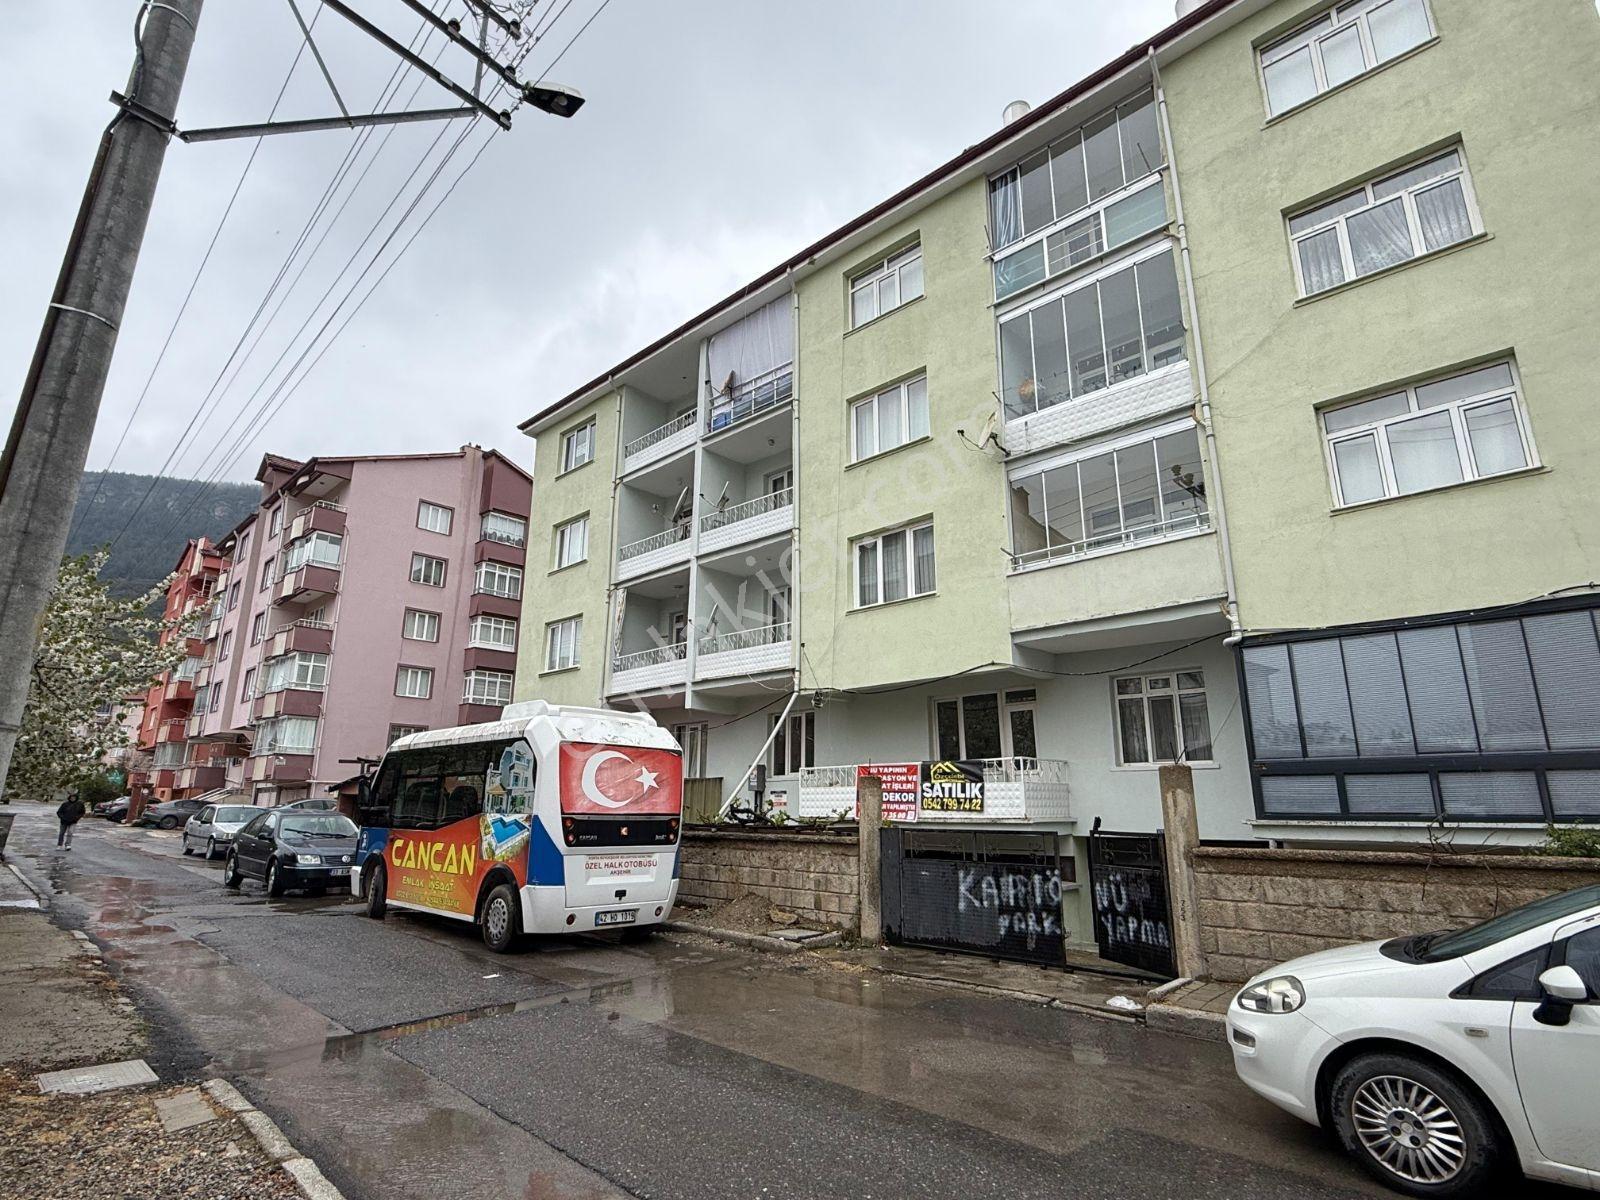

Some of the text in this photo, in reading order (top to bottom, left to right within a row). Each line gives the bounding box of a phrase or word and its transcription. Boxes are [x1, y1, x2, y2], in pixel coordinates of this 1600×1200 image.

[922, 782, 983, 799] SATILIK
[882, 792, 915, 802] DEKOR
[922, 798, 982, 810] 0542 799 74 22
[391, 838, 477, 877] CANCAN
[603, 861, 624, 869] HALK
